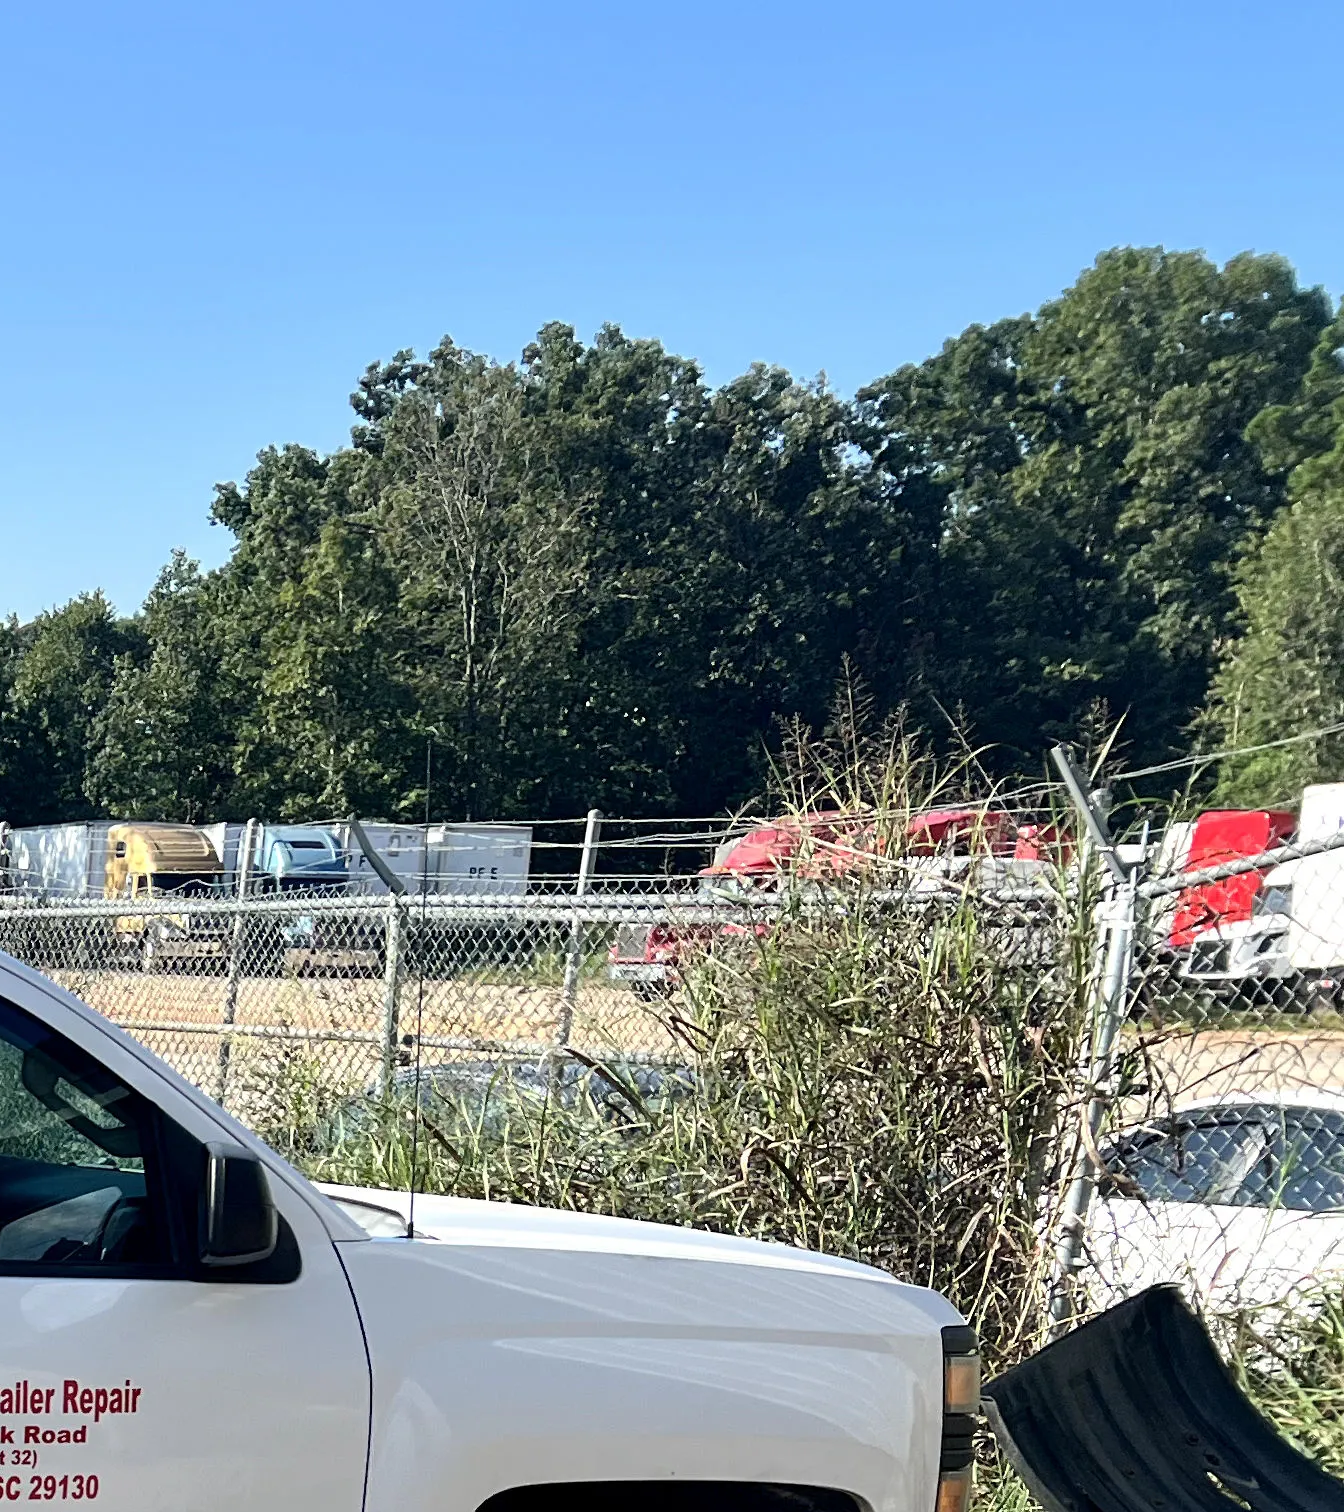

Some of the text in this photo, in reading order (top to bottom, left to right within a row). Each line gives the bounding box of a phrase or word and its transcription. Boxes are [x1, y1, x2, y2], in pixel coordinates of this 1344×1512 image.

[62, 1379, 142, 1422] Repair
[23, 1425, 87, 1444] Road
[11, 1450, 38, 1469] 32)
[28, 1474, 99, 1500] 29130
